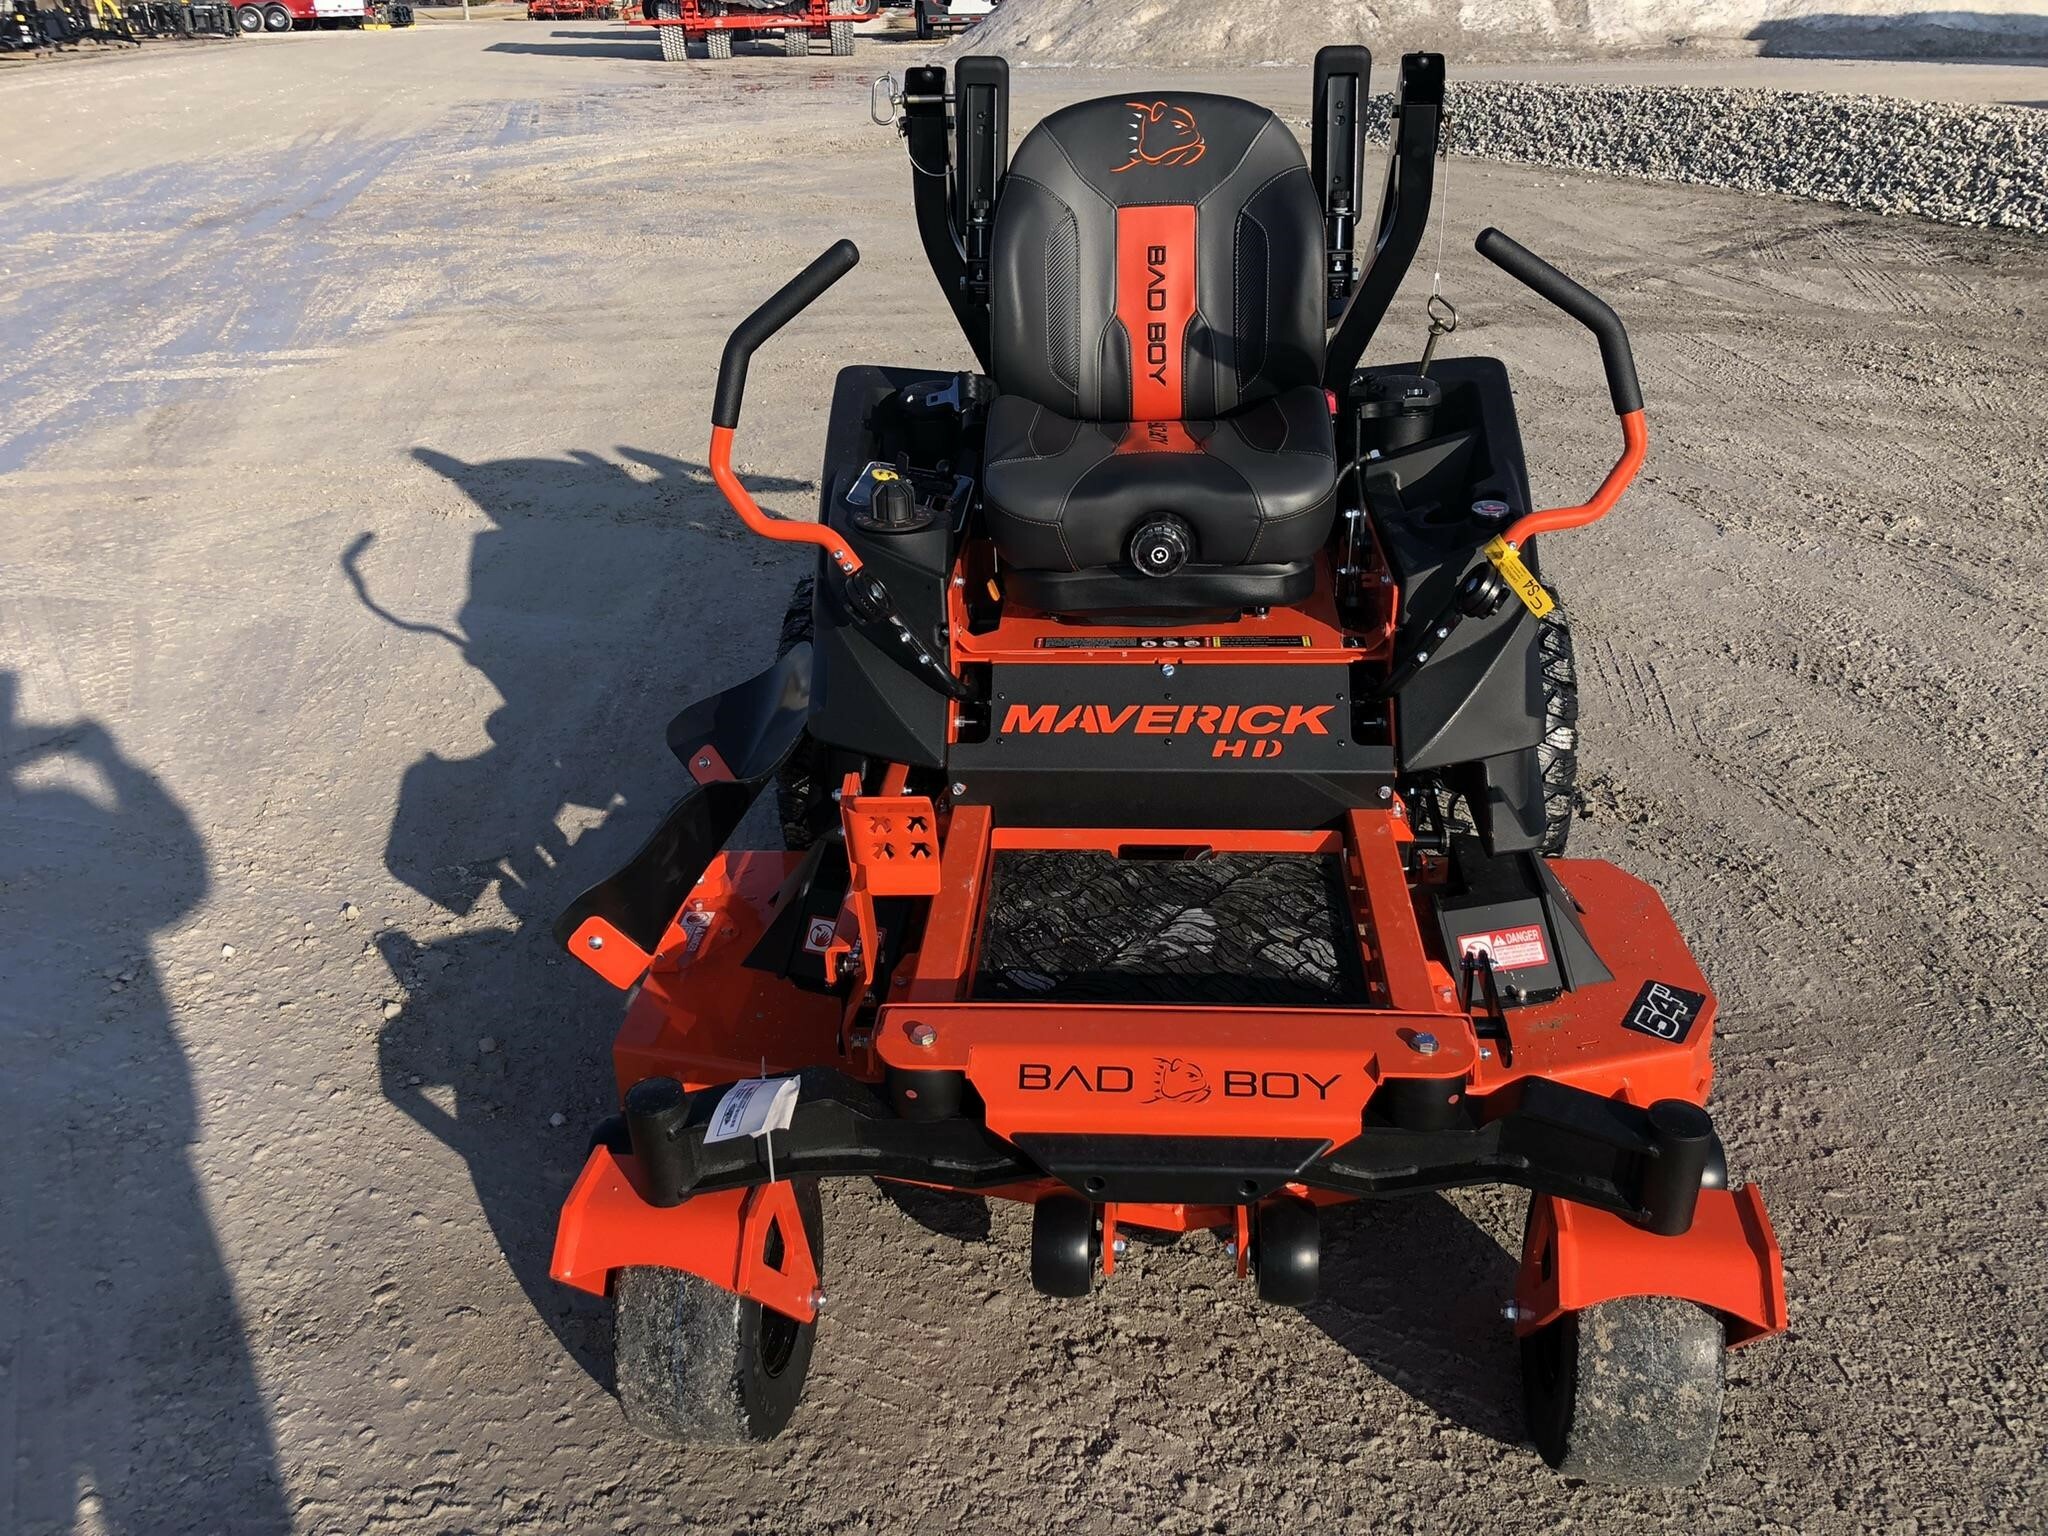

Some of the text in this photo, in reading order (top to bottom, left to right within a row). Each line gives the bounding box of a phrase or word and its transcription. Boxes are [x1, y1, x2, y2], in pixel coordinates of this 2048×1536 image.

[1147, 245, 1167, 386] BAD BOY
[1000, 704, 1336, 735] MAVERICK
[1211, 739, 1283, 758] HD
[1505, 929, 1540, 945] DANGER
[1018, 1063, 1342, 1100] BAD BOY
